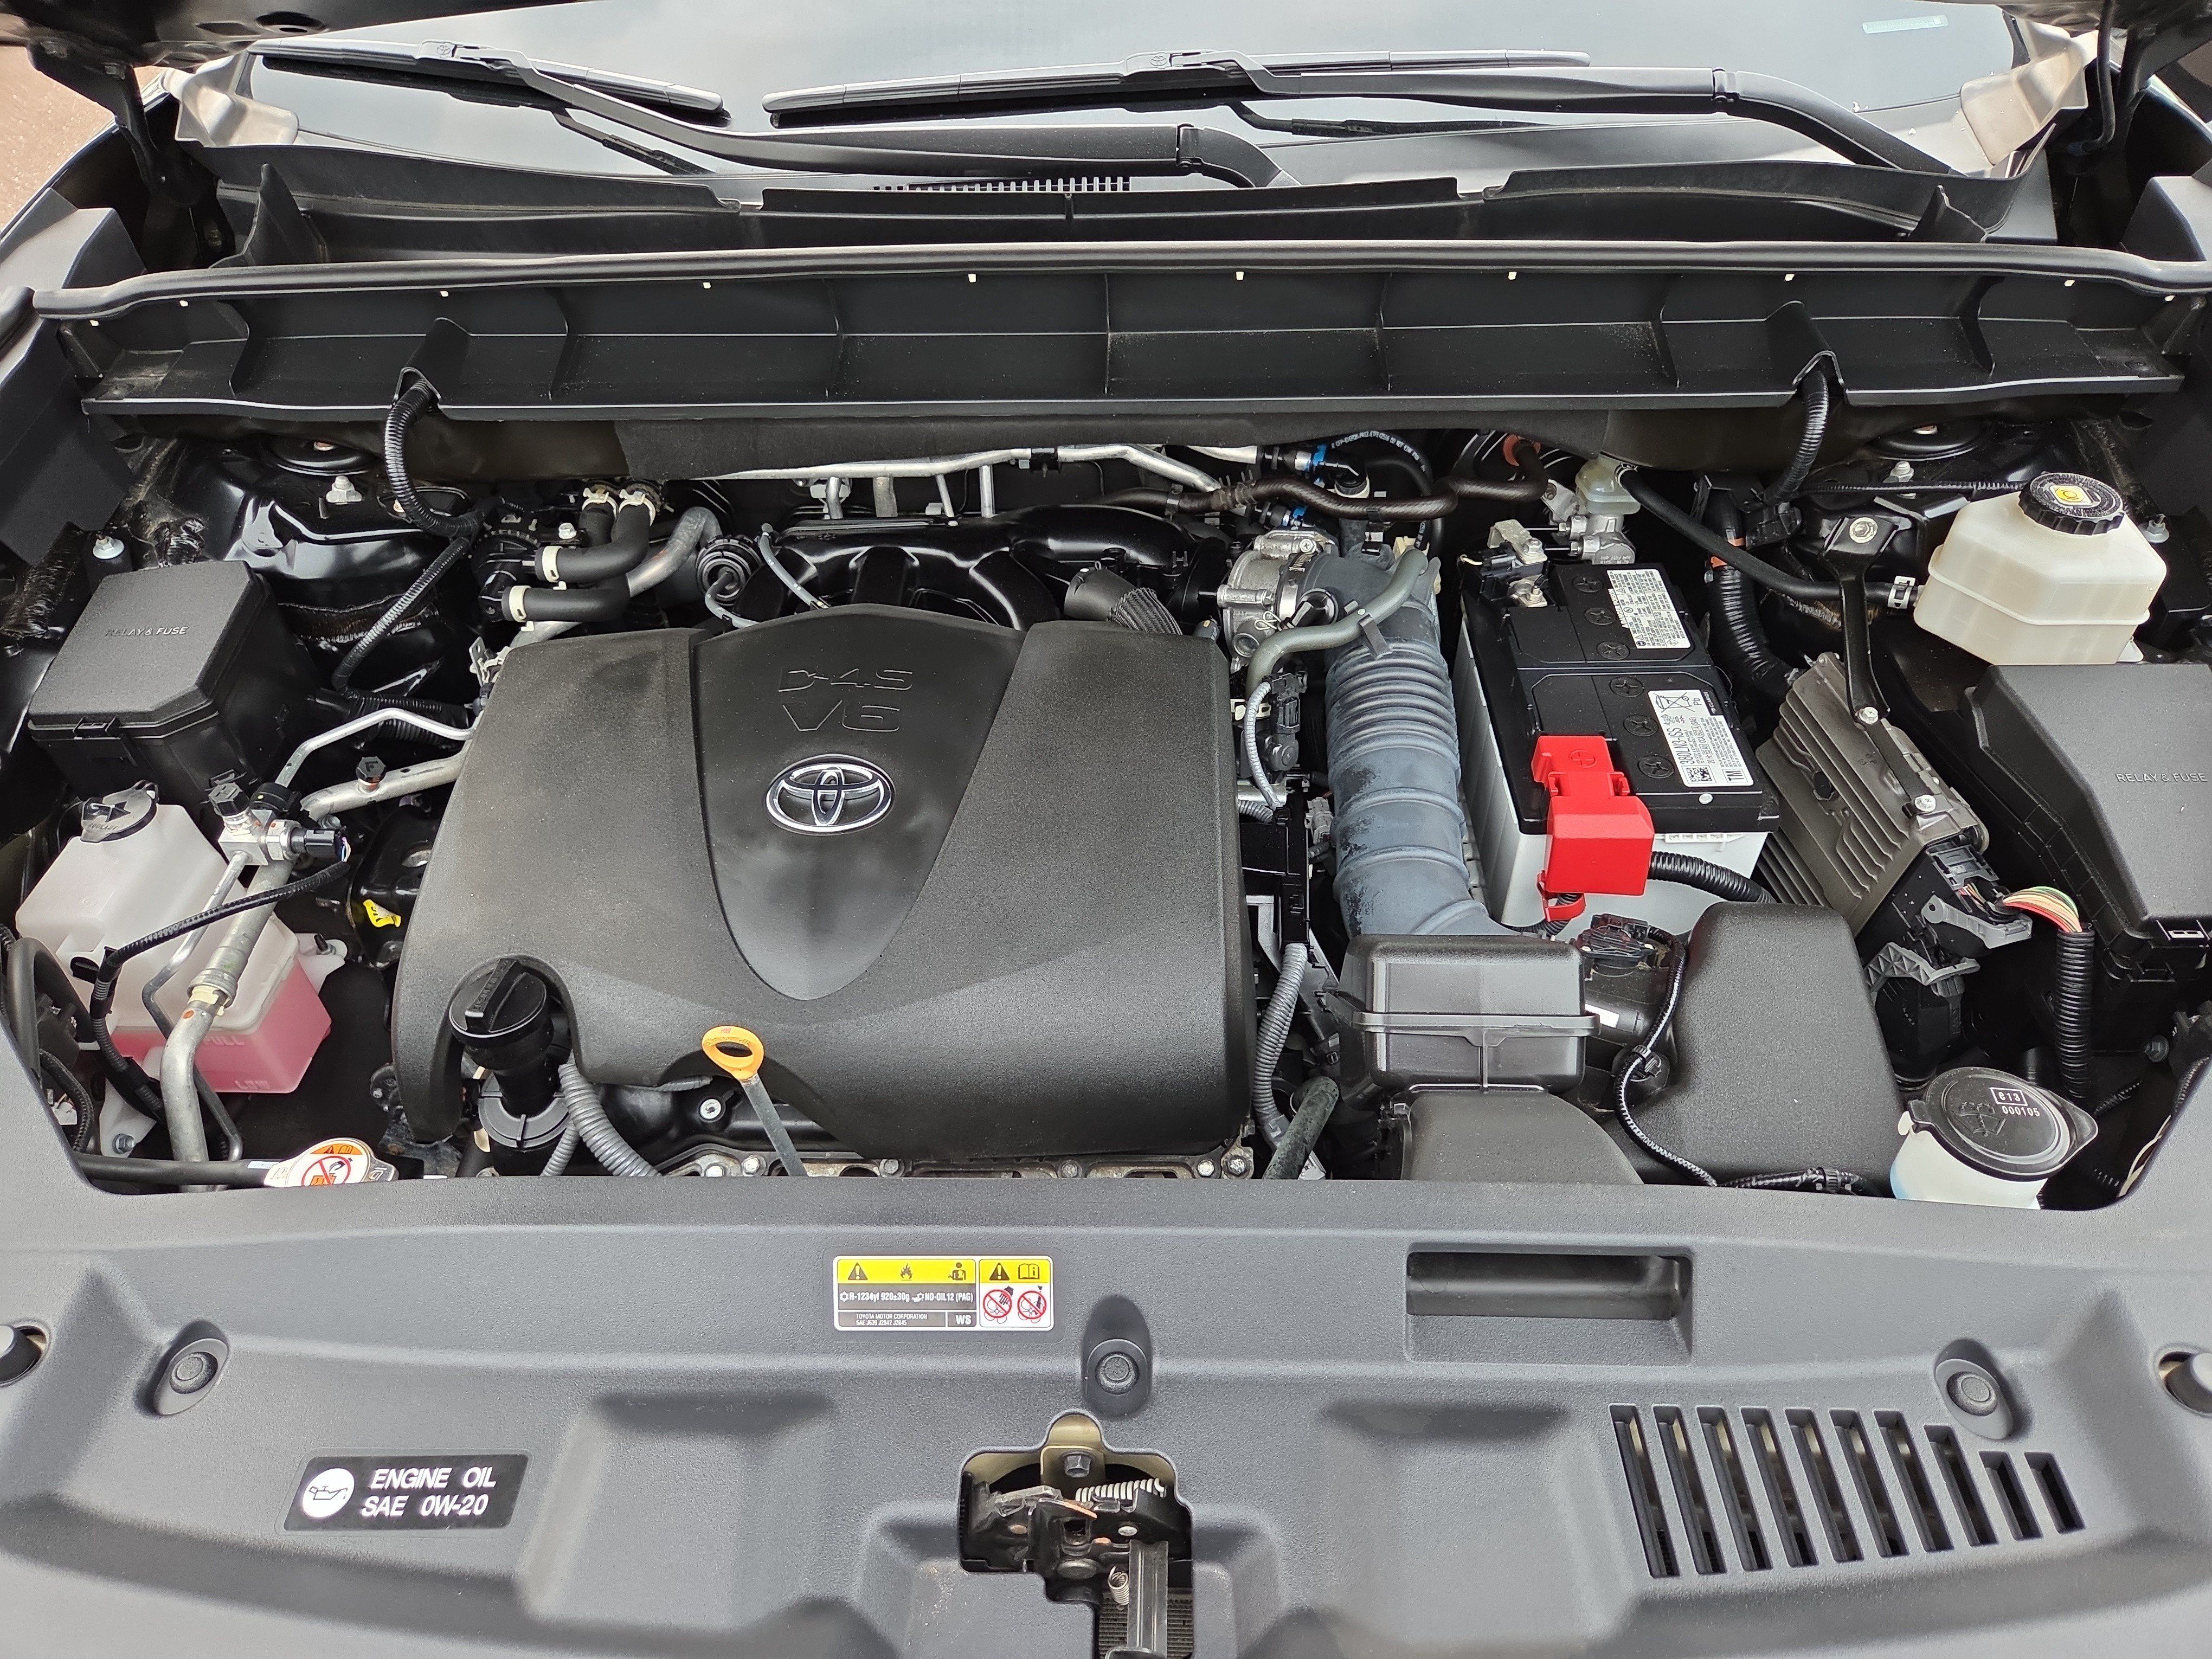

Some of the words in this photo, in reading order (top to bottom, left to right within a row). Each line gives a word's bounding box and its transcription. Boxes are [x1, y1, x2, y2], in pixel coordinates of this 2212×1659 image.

[156, 627, 188, 635] FUSE
[782, 700, 900, 732] V6
[1666, 728, 1695, 764] 380LN3-ISS
[1725, 770, 1745, 781] TM
[2115, 773, 2157, 782] RELAY
[2161, 774, 2170, 782] &
[2172, 773, 2208, 782] FUSE
[1998, 1092, 2021, 1102] e13
[2002, 1105, 2040, 1117] 000105
[849, 1293, 879, 1302] R-1234yf
[880, 1293, 910, 1302] 920±30g
[925, 1293, 954, 1301] ND-OIL12
[956, 1293, 973, 1303] (PAG)
[956, 1314, 972, 1324] WS
[370, 1467, 453, 1489] ENGINE
[462, 1467, 497, 1488] OIL
[361, 1495, 409, 1516] SAE
[421, 1494, 489, 1516] 0W-20
